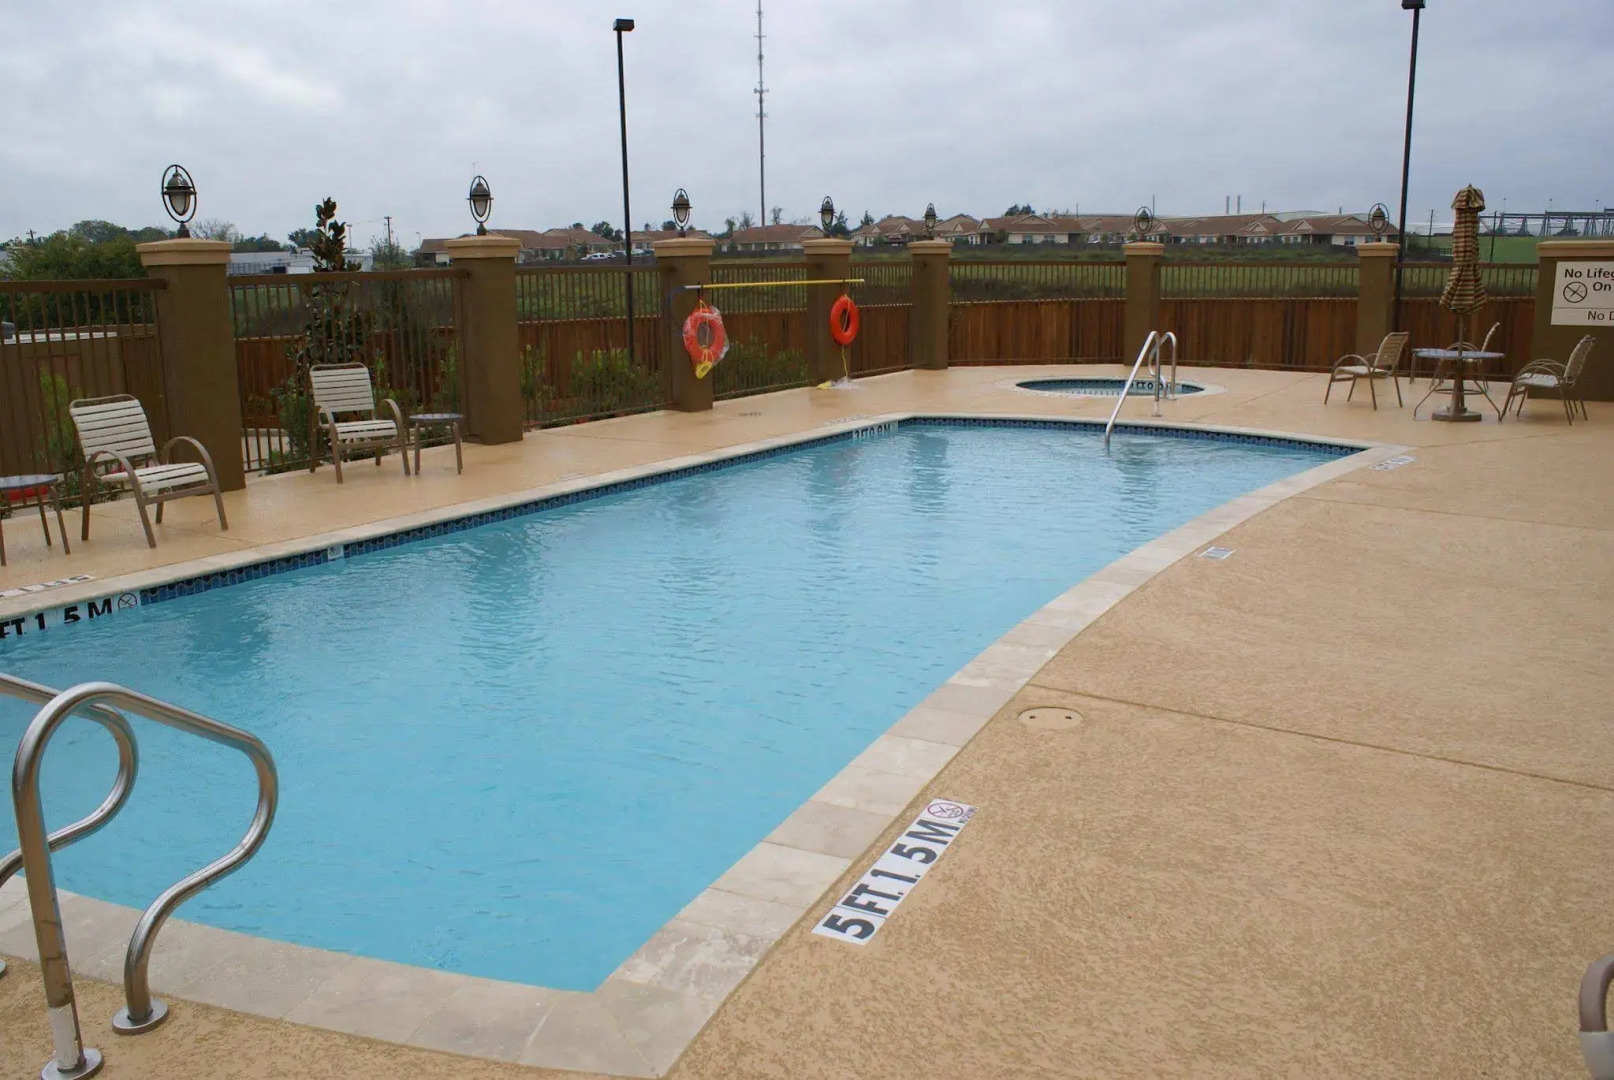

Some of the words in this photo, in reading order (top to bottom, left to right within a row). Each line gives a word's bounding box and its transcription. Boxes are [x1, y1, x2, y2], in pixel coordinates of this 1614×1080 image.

[1564, 268, 1583, 278] No
[1593, 281, 1612, 291] On
[1588, 310, 1605, 321] No
